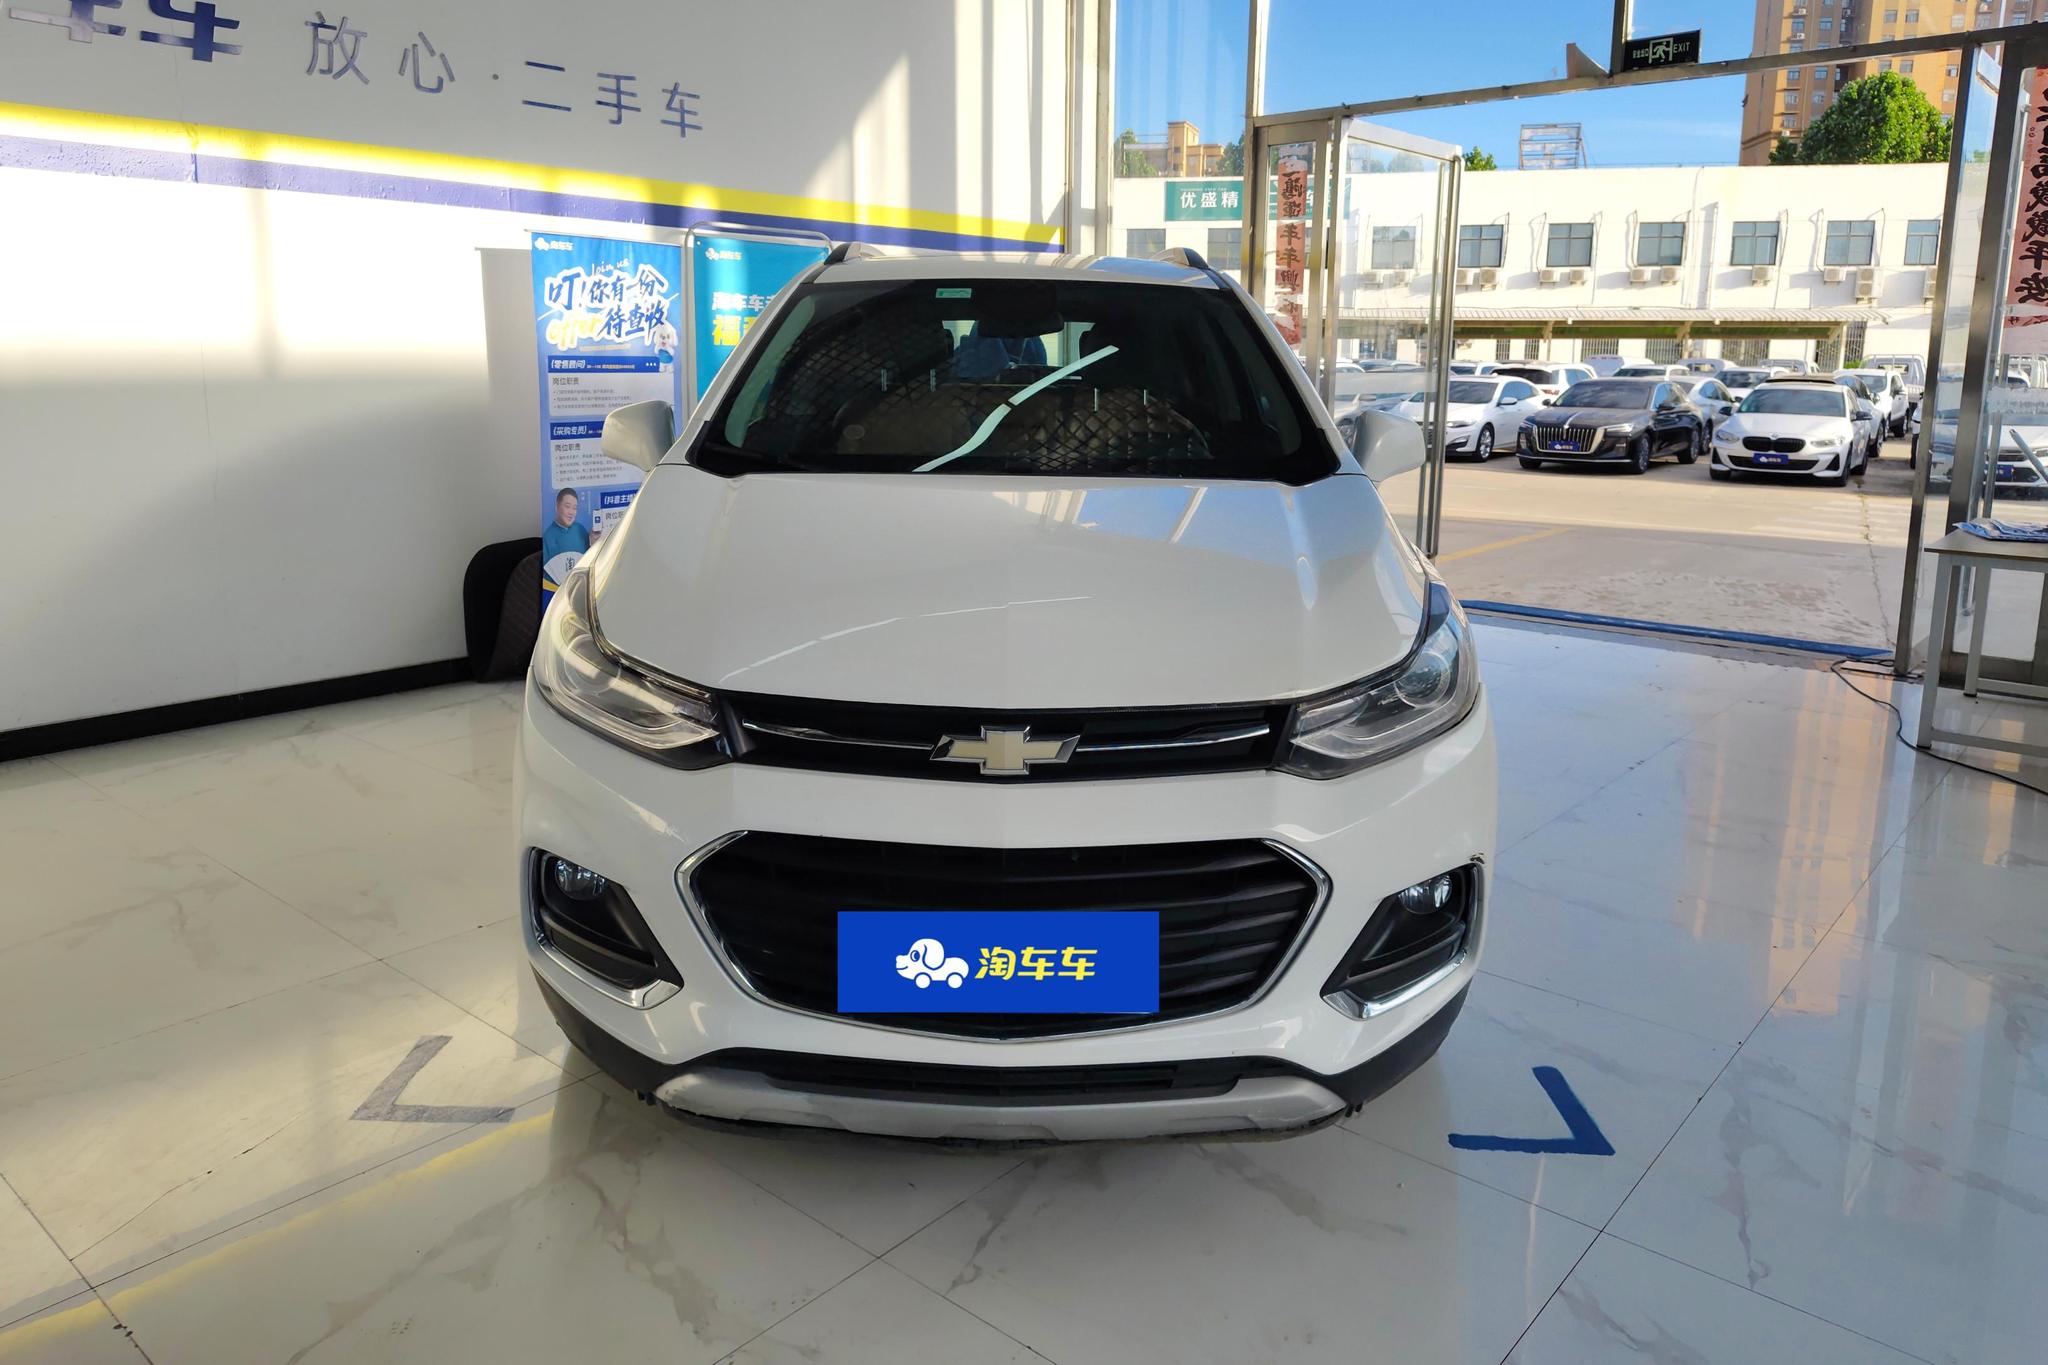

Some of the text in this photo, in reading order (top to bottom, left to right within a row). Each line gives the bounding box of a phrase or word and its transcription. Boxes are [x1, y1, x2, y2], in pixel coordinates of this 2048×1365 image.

[1673, 42, 1691, 54] EXIT
[1180, 191, 1239, 209] 优盛精
[597, 300, 665, 340] 待查收
